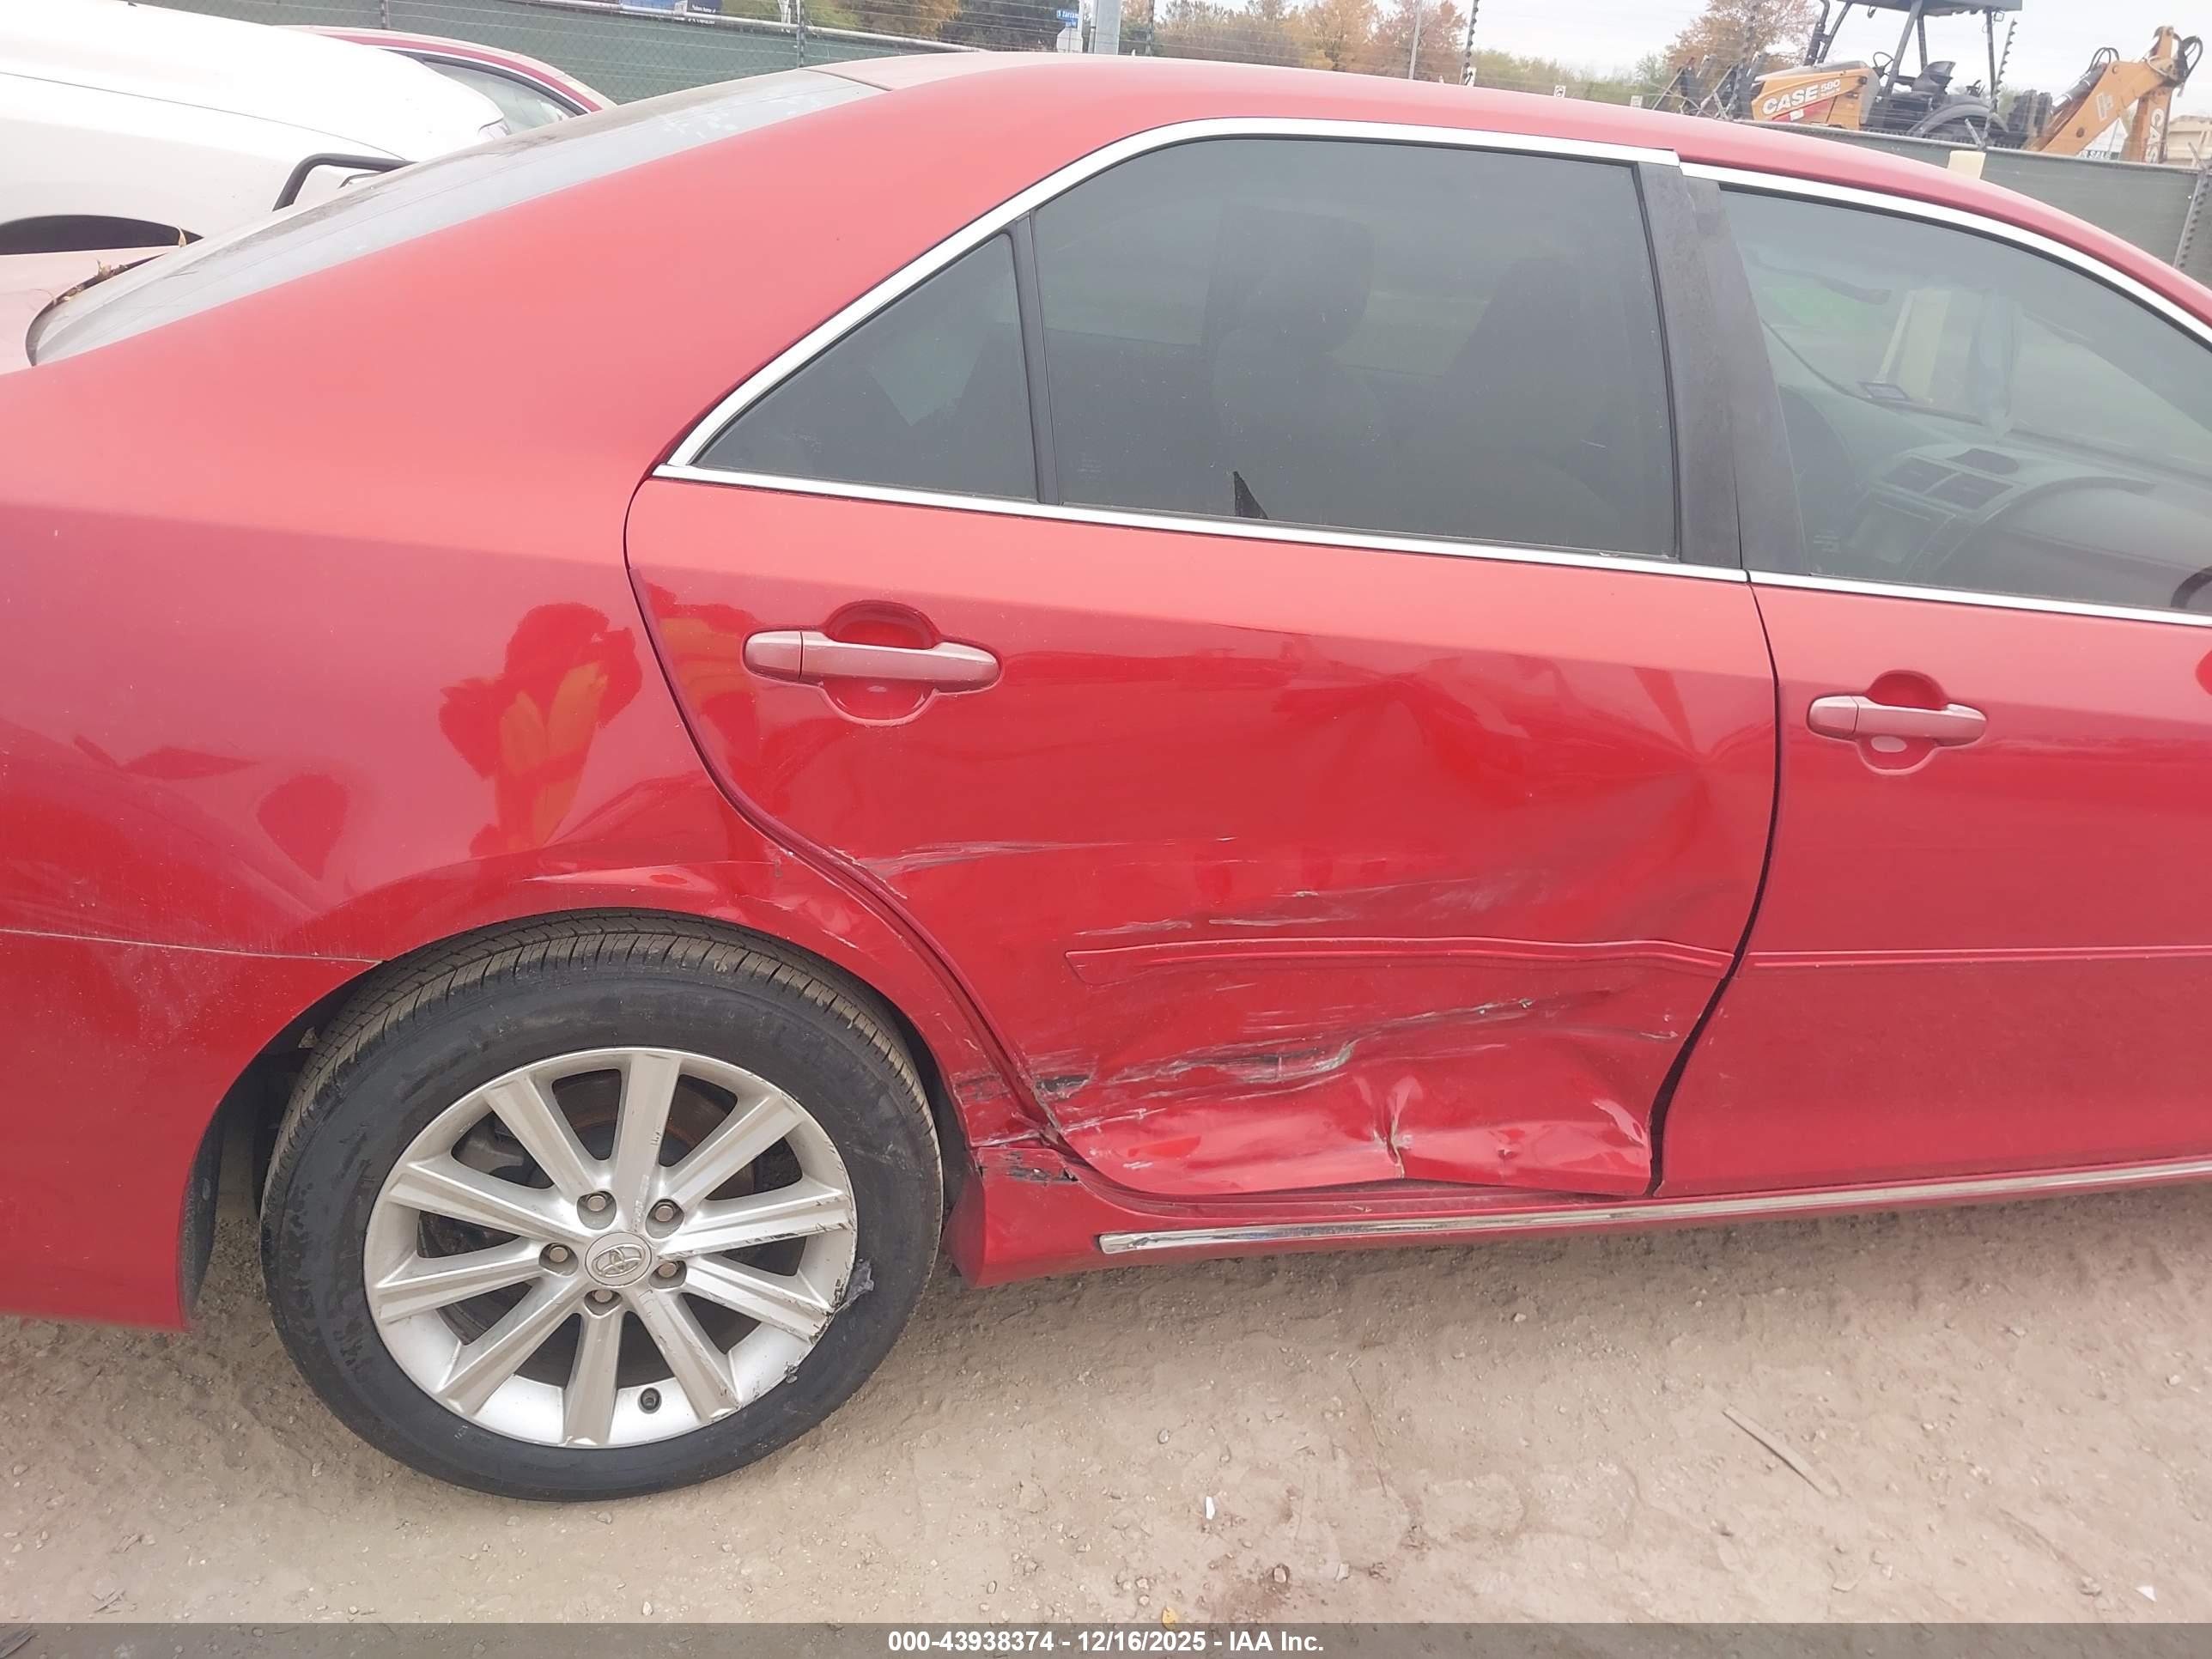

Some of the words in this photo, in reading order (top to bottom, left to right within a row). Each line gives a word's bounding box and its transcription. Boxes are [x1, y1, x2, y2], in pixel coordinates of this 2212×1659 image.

[1762, 84, 1819, 115] CASE
[1820, 78, 1841, 92] 580
[2145, 107, 2165, 163] CAS
[2088, 150, 2112, 160] SALE
